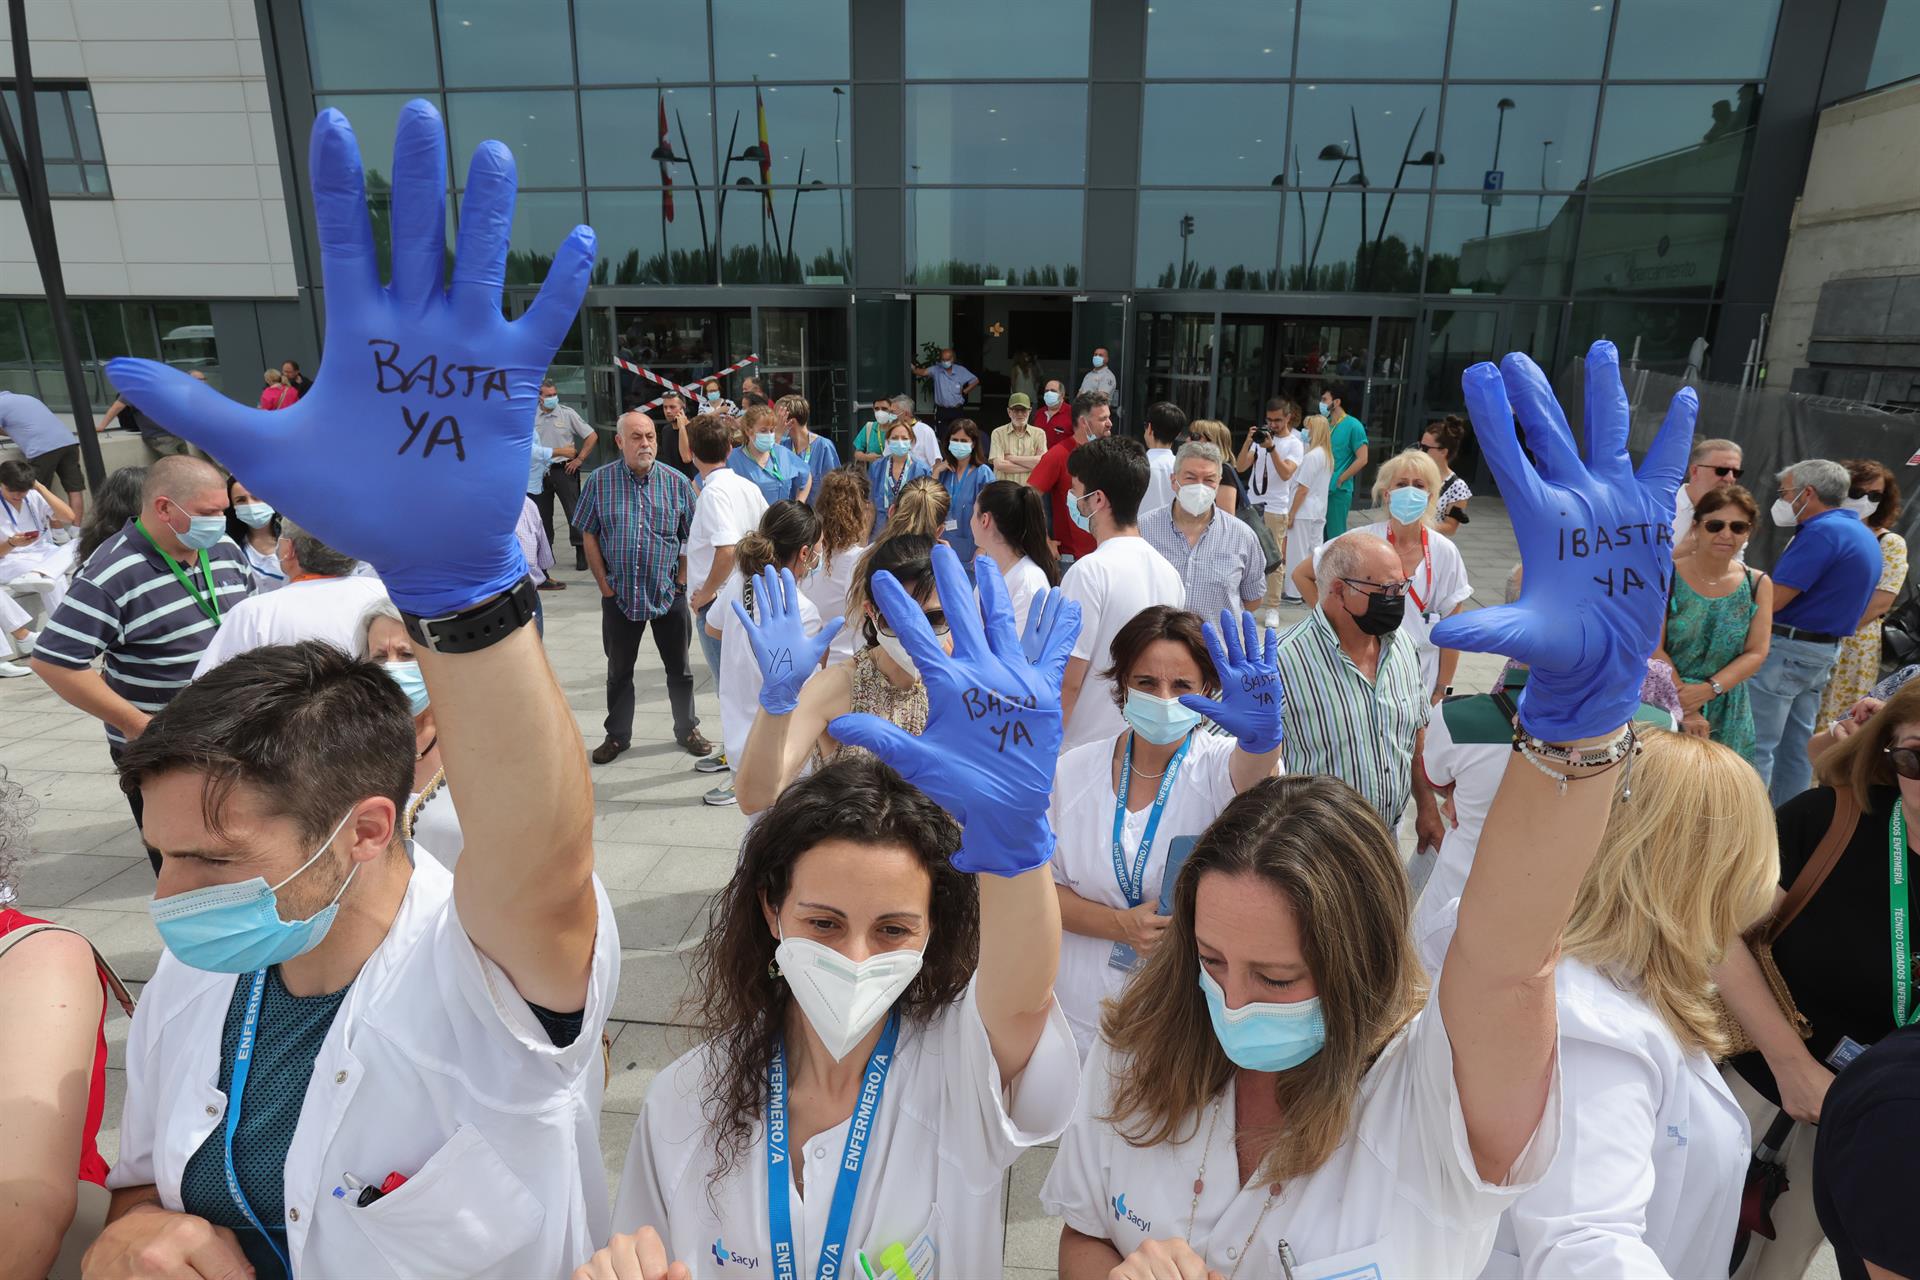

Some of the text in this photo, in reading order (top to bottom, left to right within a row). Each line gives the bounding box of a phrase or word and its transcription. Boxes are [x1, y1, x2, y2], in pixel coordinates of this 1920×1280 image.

[368, 339, 511, 401] BASTA
[397, 406, 466, 462] YA
[767, 647, 793, 674] YA
[1252, 692, 1275, 707] YA
[990, 720, 1034, 753] YA
[1156, 753, 1184, 806] ENFERMERO/A
[1132, 840, 1151, 899] ENFERMERO/A
[1894, 907, 1904, 940] TÉCNICO
[1895, 941, 1906, 980] CUIDADOS
[770, 1038, 785, 1165] ENFERMERO/A
[844, 1054, 888, 1172] ENFERMERO/A
[1127, 1209, 1151, 1232] Sacyl
[731, 1251, 759, 1269] Sacyl
